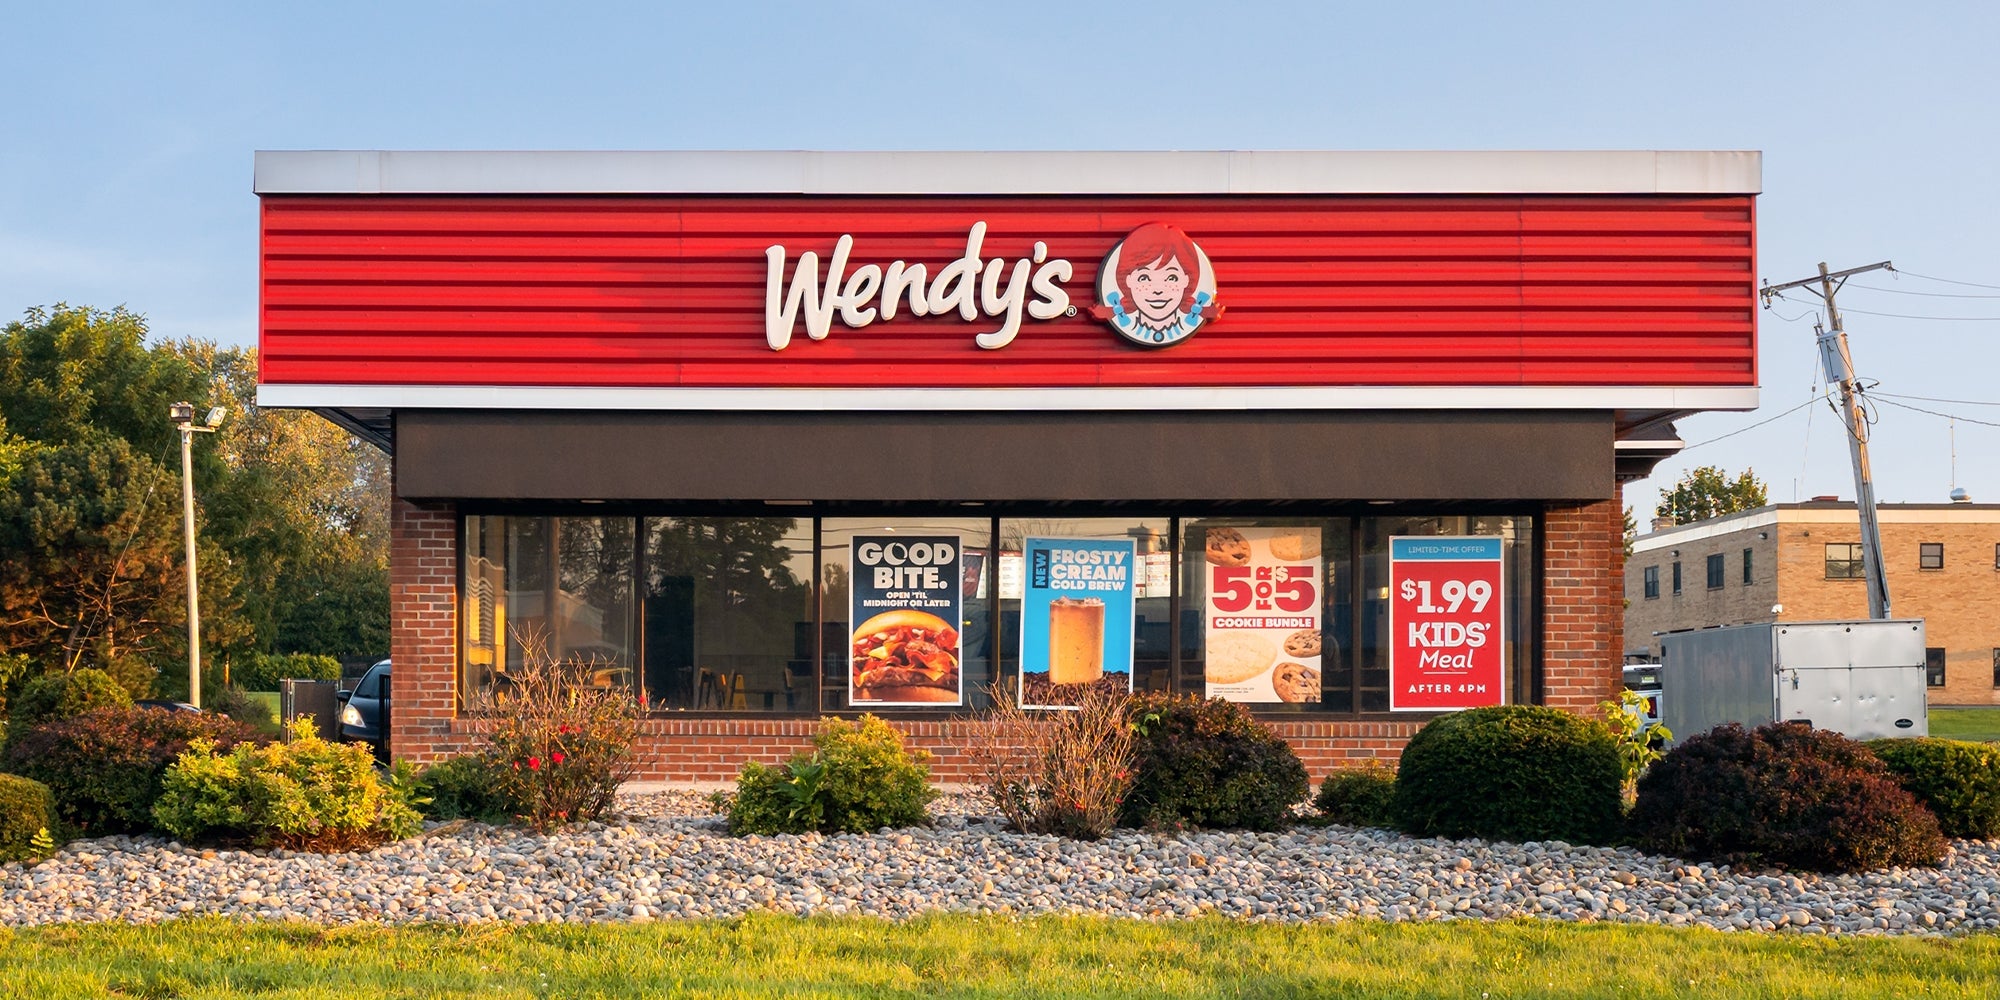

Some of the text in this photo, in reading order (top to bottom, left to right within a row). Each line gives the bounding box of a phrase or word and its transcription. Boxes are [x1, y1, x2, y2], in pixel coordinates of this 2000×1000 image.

[765, 221, 1073, 350] Wendy's
[858, 542, 955, 566] GOOD
[1051, 549, 1126, 565] FROSTY
[874, 567, 948, 589] BITE.
[1035, 552, 1047, 586] NEW
[1051, 564, 1126, 580] CREAM
[886, 591, 910, 599] OPEN
[1050, 580, 1125, 591] COLD BREW
[1212, 566, 1253, 612] 5
[1255, 566, 1272, 610] FOR
[1401, 578, 1493, 613] $1.99
[1215, 618, 1312, 628] COOKIE BUNDLE
[1419, 649, 1474, 669] Meal
[1408, 684, 1486, 693] AFTER 4PM
